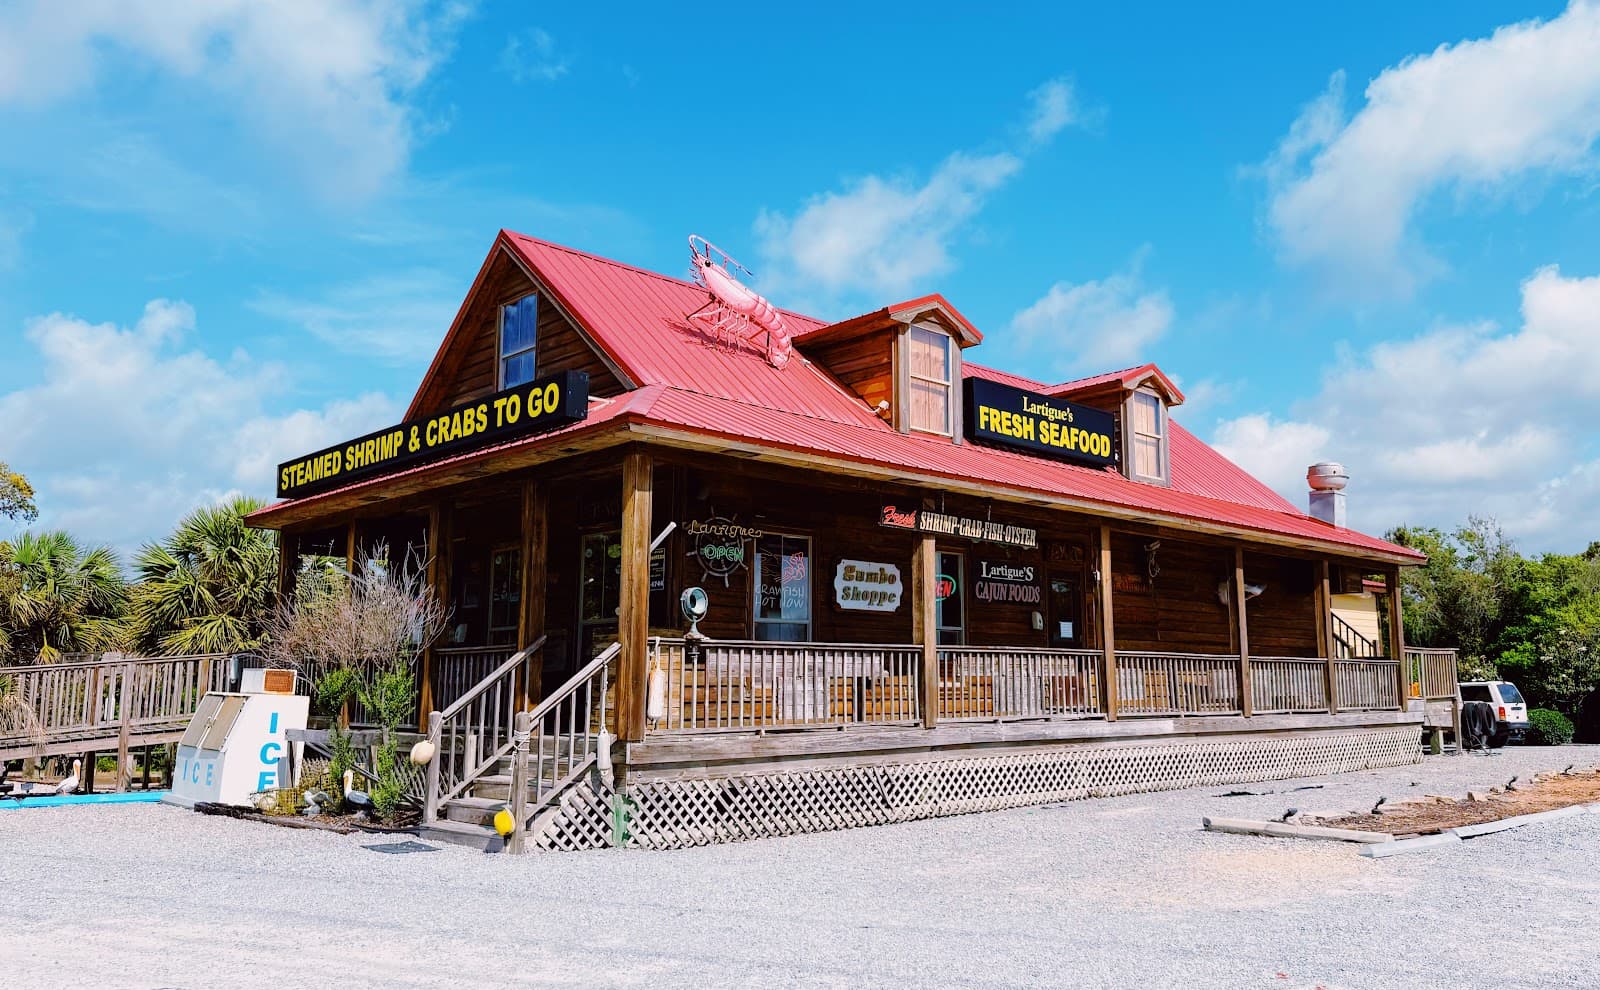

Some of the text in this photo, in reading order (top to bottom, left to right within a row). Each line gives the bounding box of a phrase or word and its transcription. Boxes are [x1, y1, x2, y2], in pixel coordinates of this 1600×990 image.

[1022, 395, 1074, 423] Lartigue's
[281, 383, 560, 491] STEAMED SHRIMP & CRABS TO GO
[979, 405, 1111, 457] FRESH SEAFOOD
[883, 505, 917, 529] Fresh
[703, 543, 744, 562] OPEN
[842, 565, 897, 585] Gumbo
[841, 586, 897, 606] Shoppe
[975, 581, 1041, 604] CAJUN FOODS
[257, 712, 281, 793] ICE
[182, 759, 214, 786] ICE
